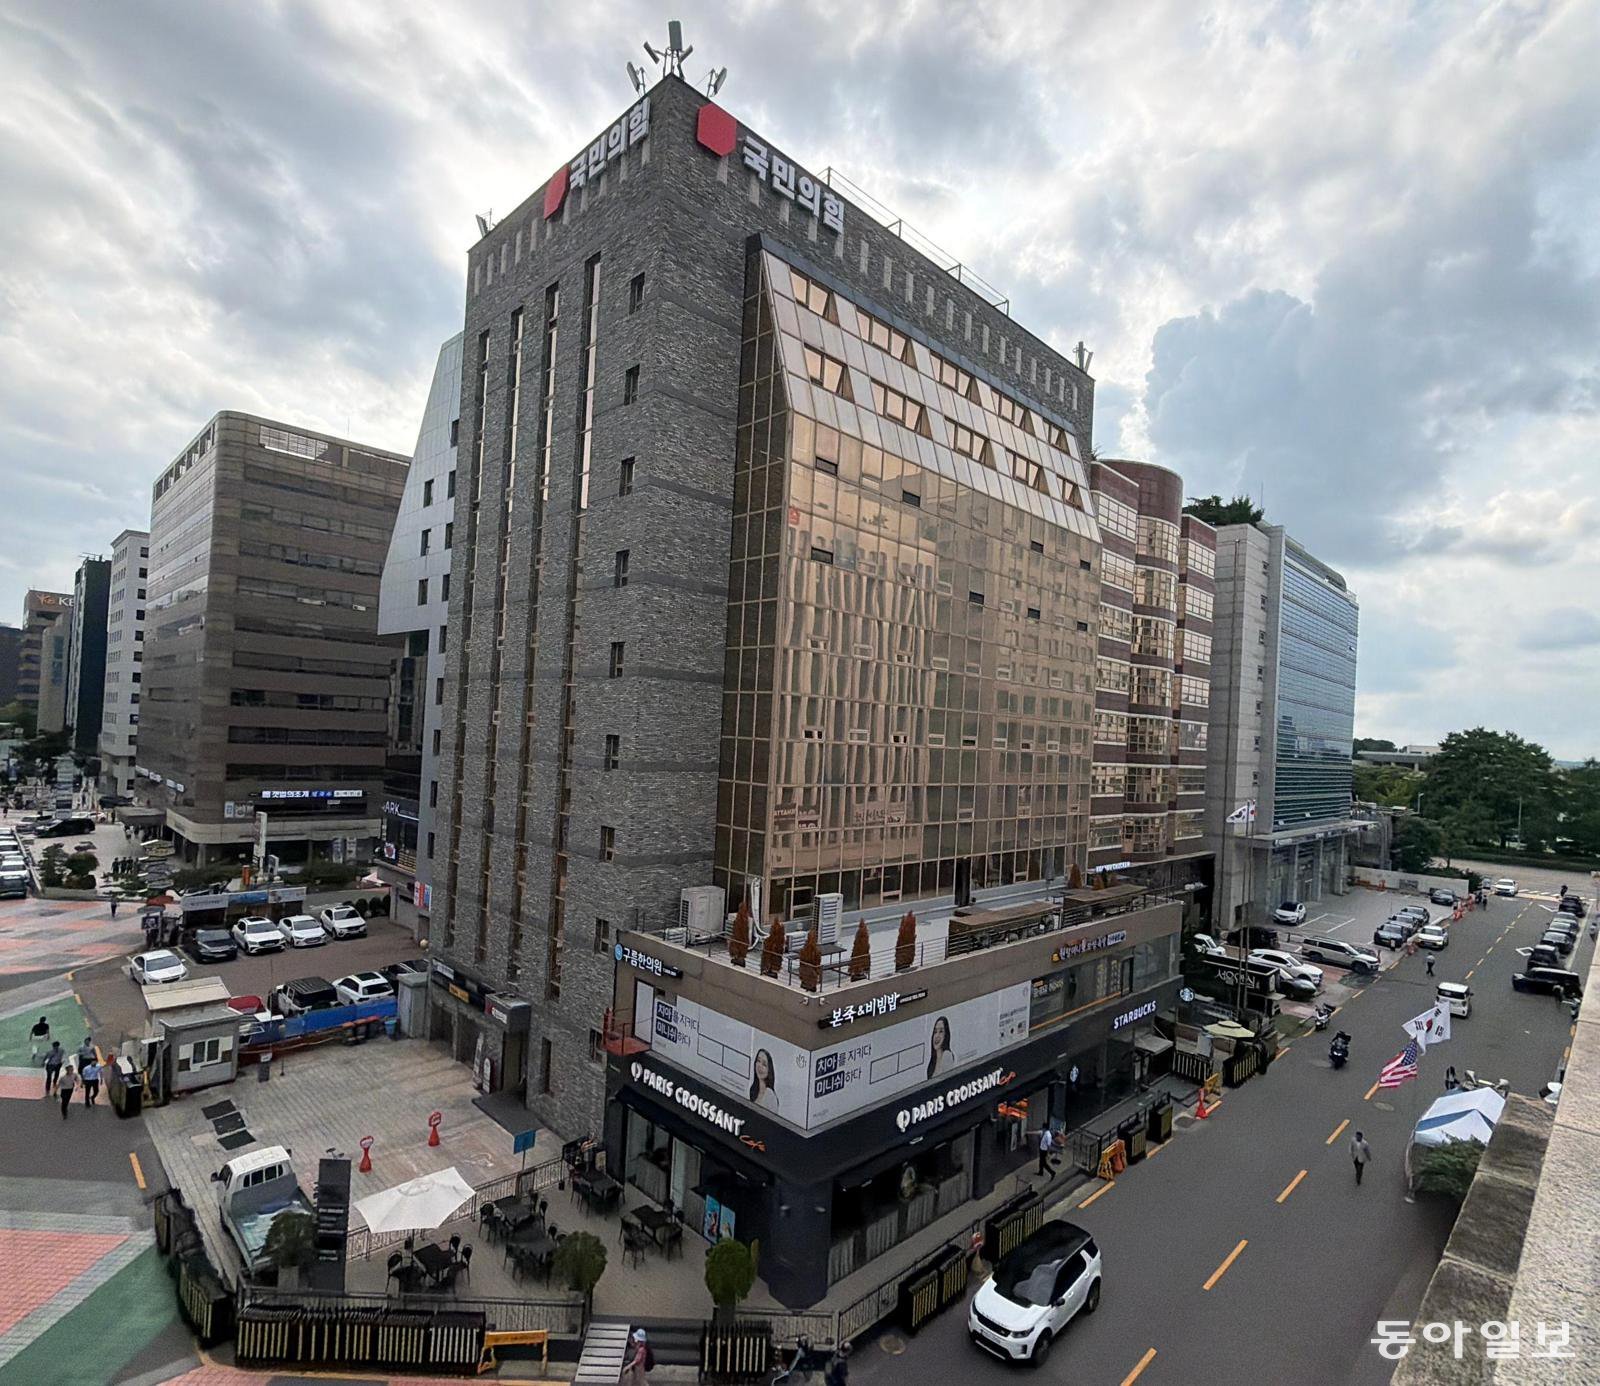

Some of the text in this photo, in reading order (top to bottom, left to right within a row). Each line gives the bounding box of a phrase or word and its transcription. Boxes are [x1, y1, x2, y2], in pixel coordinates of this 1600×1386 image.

[569, 97, 650, 190] 국민의힘
[743, 136, 845, 236] 국민의힘
[623, 947, 662, 977] 구름한의원
[830, 991, 900, 1028] 본죽&비빔밥
[1113, 1000, 1157, 1030] STARBUCKS
[816, 1044, 872, 1074] 치아를 지키다
[815, 1067, 862, 1094] 미니쉬하다
[911, 1096, 944, 1124] PARIS
[946, 1069, 1002, 1107] CROISSANT
[643, 1069, 674, 1097] PARIS
[675, 1087, 744, 1136] CROISSANT
